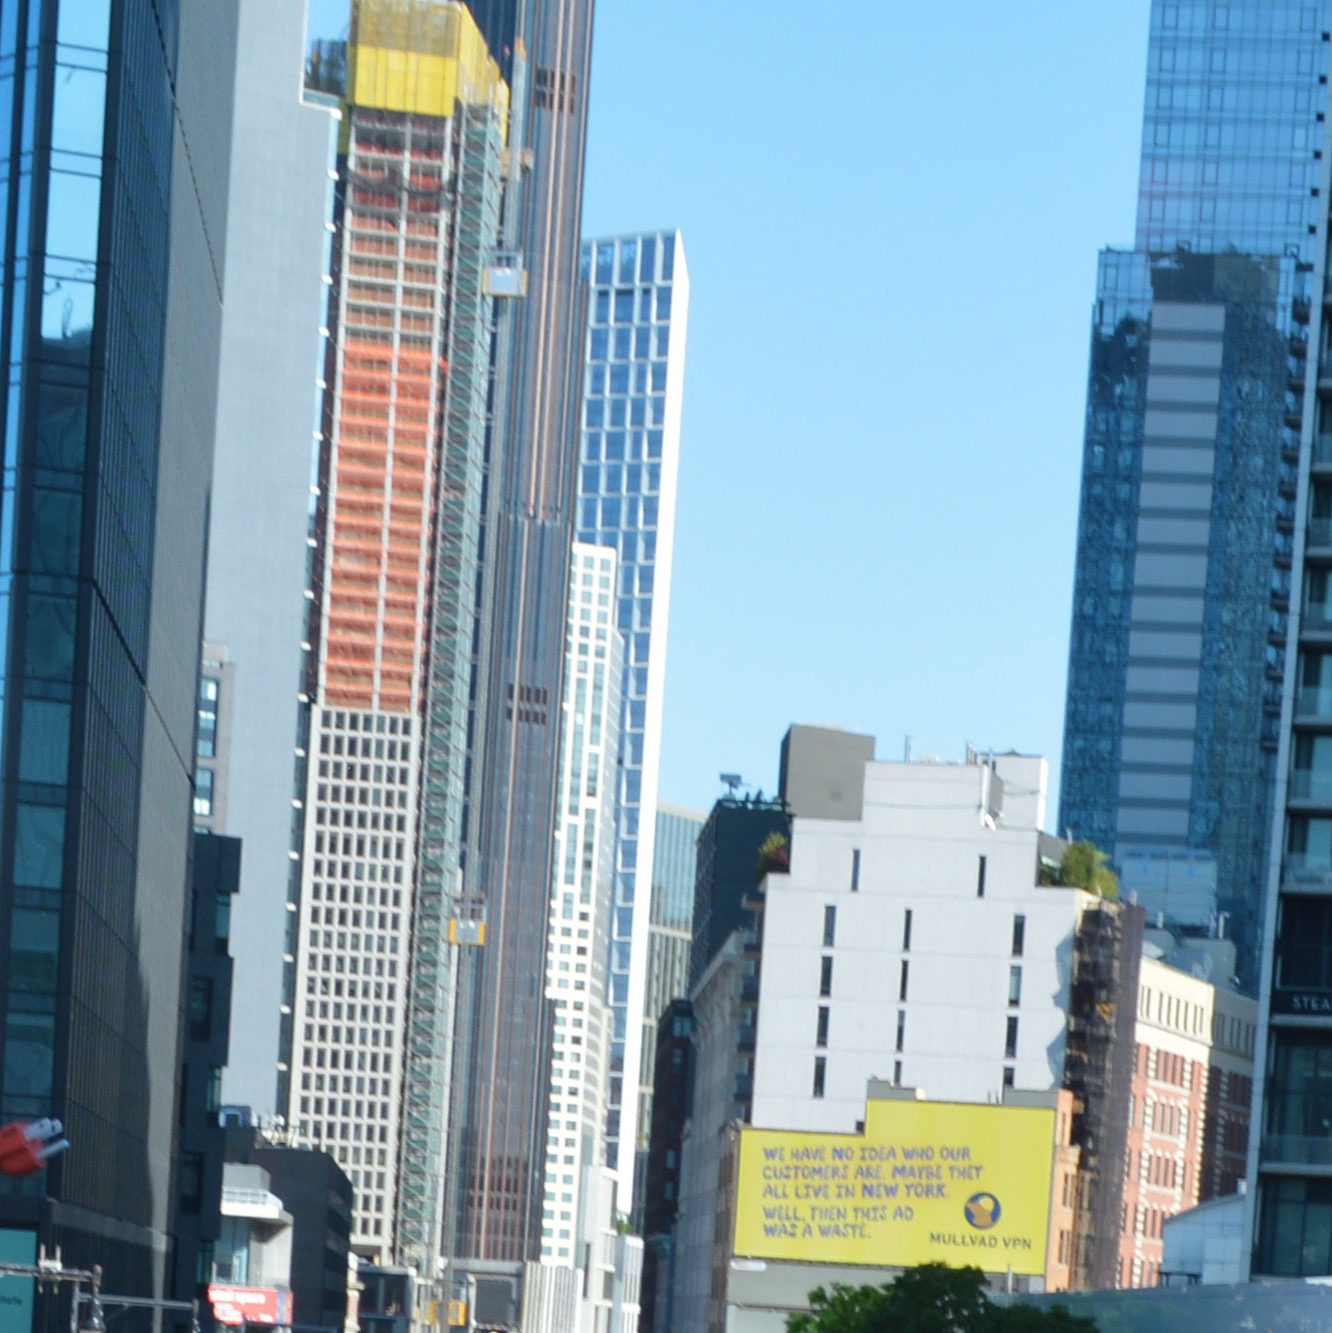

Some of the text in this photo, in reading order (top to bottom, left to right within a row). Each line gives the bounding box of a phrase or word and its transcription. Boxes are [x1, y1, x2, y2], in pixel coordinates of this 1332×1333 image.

[763, 1146, 971, 1161] WE HAVE NO IDEA WHO OUR
[763, 1165, 848, 1180] CUSTOMERS
[892, 1165, 942, 1180] MAYBE
[949, 1165, 983, 1180] THEY
[763, 1184, 789, 1199] ALL
[795, 1184, 829, 1199] LIVE
[836, 1184, 856, 1199] IN
[862, 1184, 899, 1199] NEW
[810, 1206, 847, 1221] THEN
[853, 1206, 887, 1221] THIS
[893, 1206, 914, 1221] AD
[763, 1224, 798, 1238] WAS
[802, 1224, 813, 1238] A
[929, 1232, 1032, 1249] MULLVAD VPN
